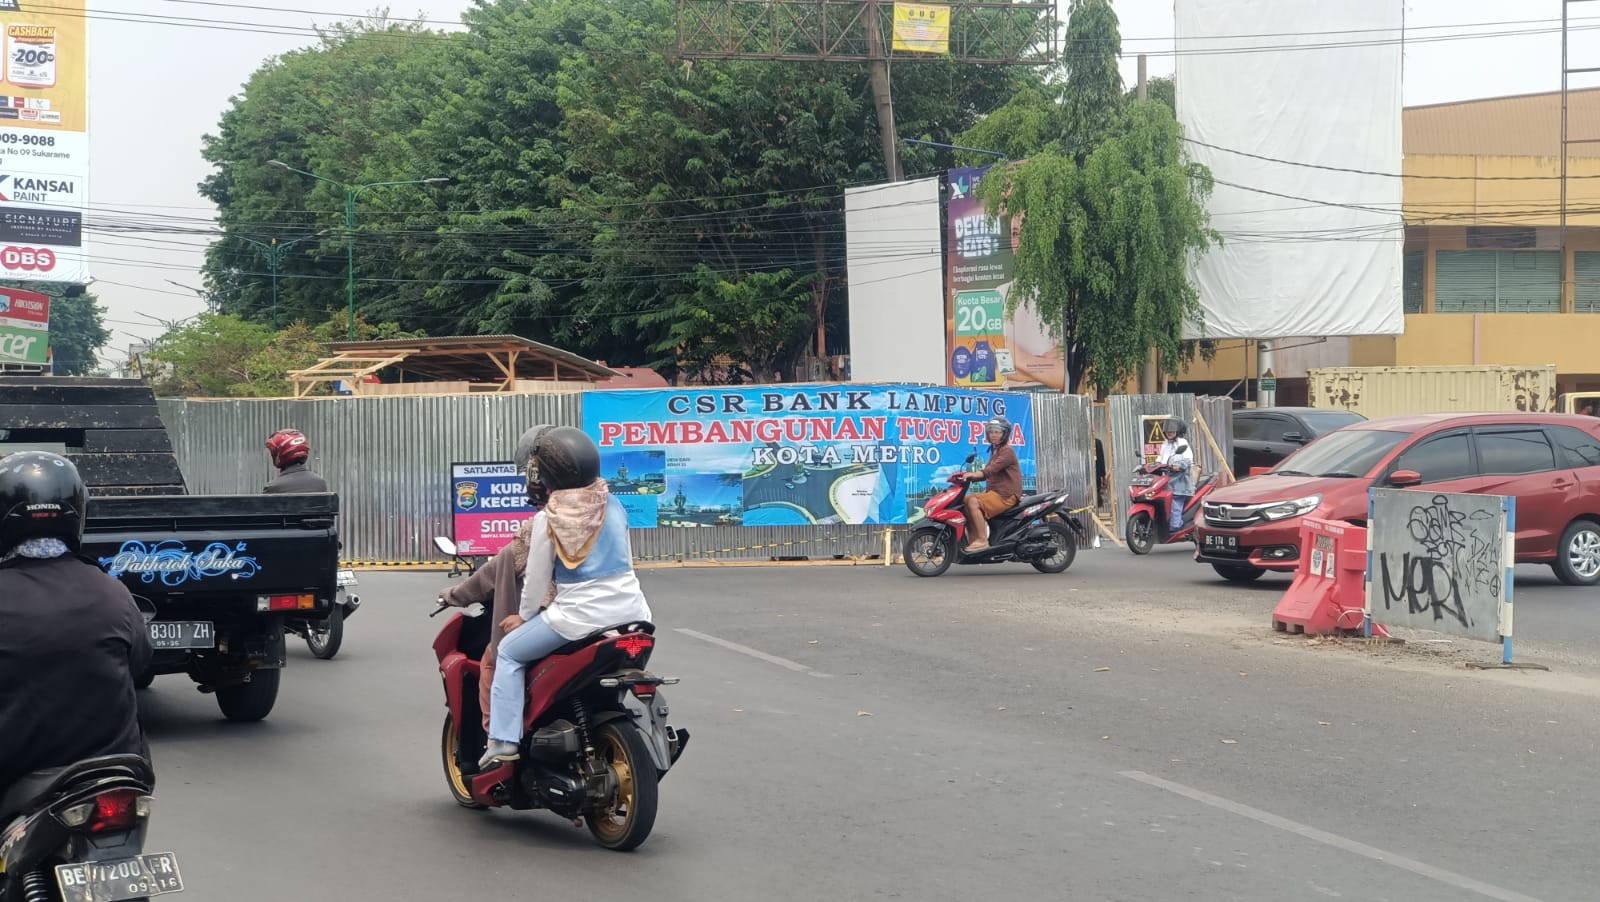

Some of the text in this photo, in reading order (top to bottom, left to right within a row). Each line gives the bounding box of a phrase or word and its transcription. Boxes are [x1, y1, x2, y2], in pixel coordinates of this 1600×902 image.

[8, 26, 56, 38] CASHBACK
[20, 148, 31, 156] 09
[32, 149, 71, 159] Sukarame
[13, 177, 74, 194] KANSAI
[13, 191, 47, 202] PAINT
[5, 213, 78, 227] SIGNATURE
[4, 249, 52, 267] DBS
[957, 297, 979, 305] Kuota
[957, 305, 1003, 332] 20 GB
[0, 332, 37, 361] cer
[667, 391, 1006, 416] CSR BANK LAMPUNG
[599, 416, 1026, 447] PEMBANGUNAN TUGU PA
[752, 445, 941, 465] KOTA METRO
[463, 466, 515, 474] SATLANTAS
[490, 483, 527, 494] KURA
[26, 503, 62, 511] HONDA
[151, 623, 209, 639] 8301 ZH
[61, 868, 86, 886] BE
[128, 877, 178, 894] 09-16
